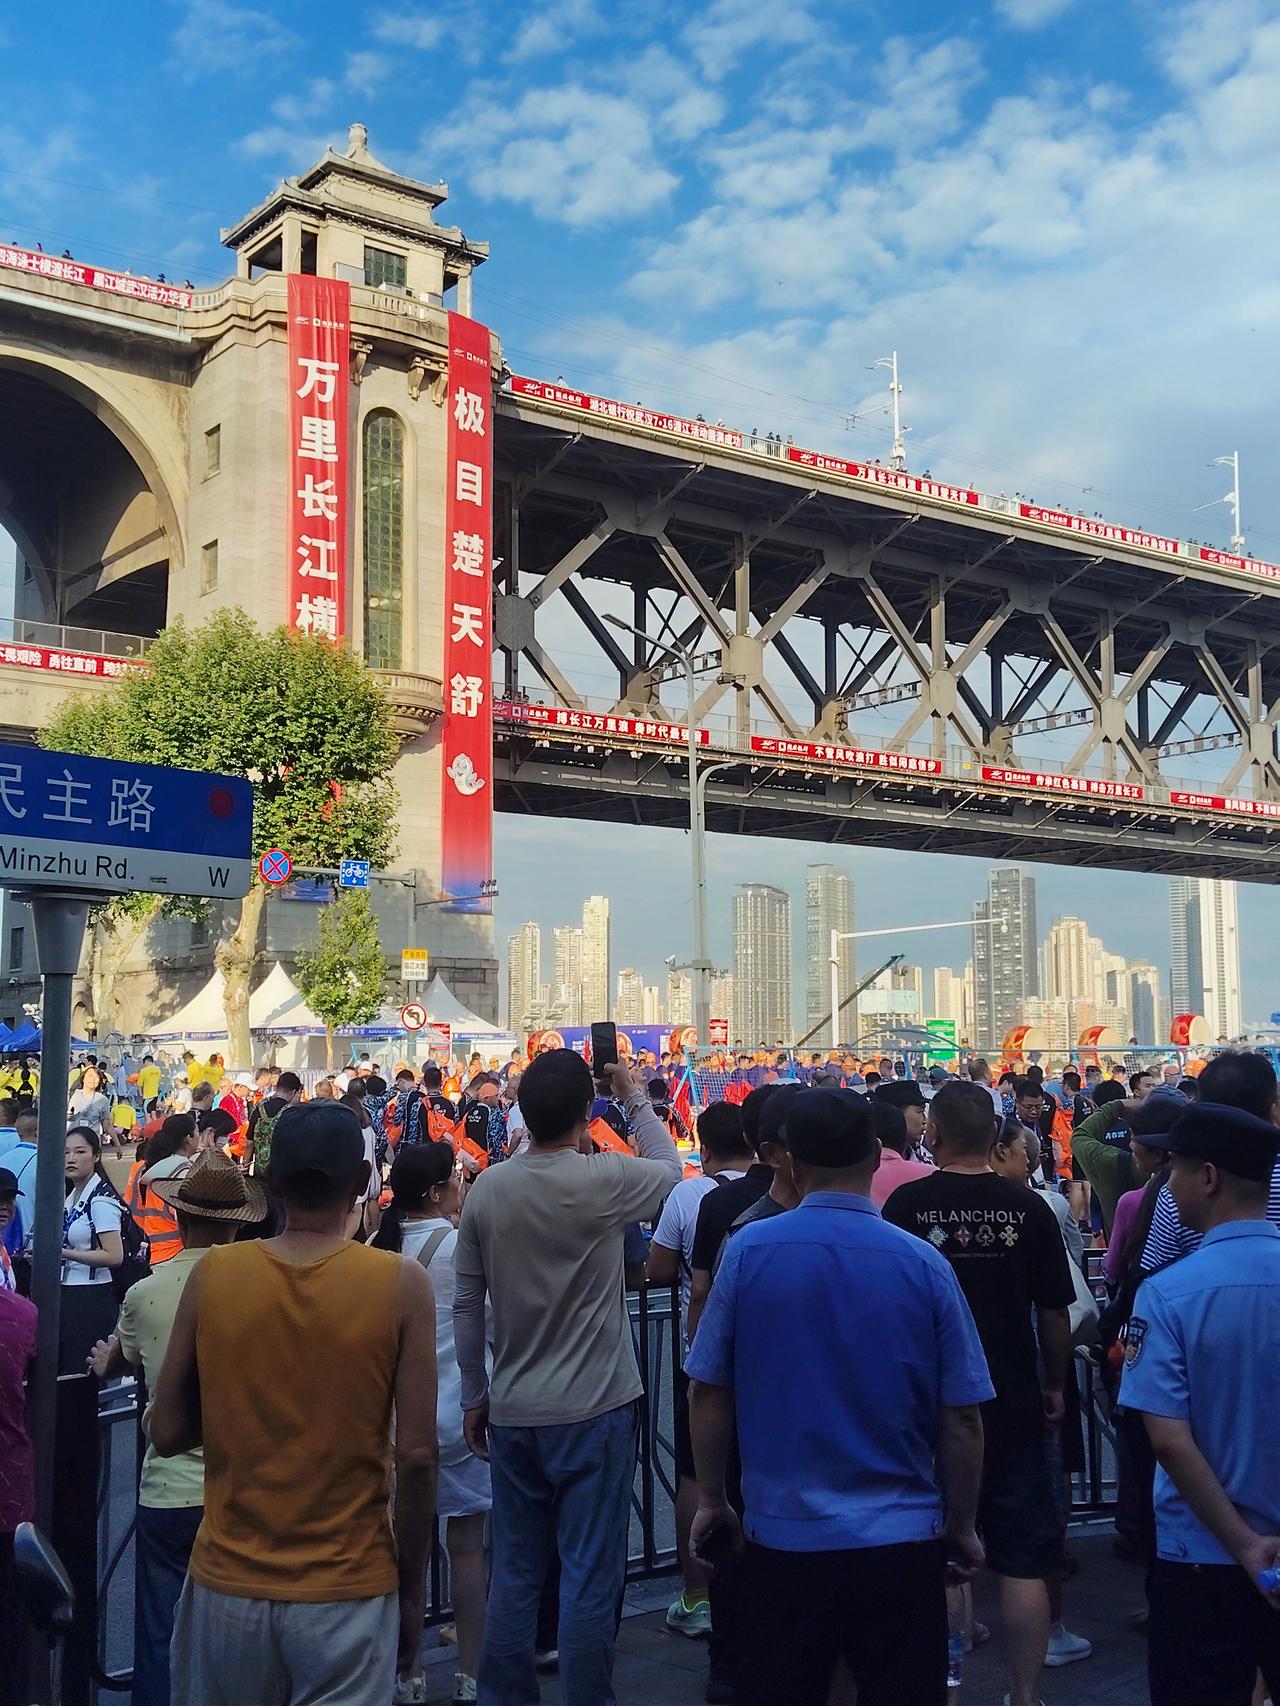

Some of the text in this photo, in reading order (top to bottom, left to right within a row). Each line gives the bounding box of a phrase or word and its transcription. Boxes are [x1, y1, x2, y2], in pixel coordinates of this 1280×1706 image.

[296, 357, 339, 641] 万里长江横
[451, 386, 485, 718] 极目楚天舒
[0, 762, 156, 833] 民主路
[0, 846, 230, 888] Minzhu Rd. W
[916, 1210, 1026, 1224] MELANCHOLY
